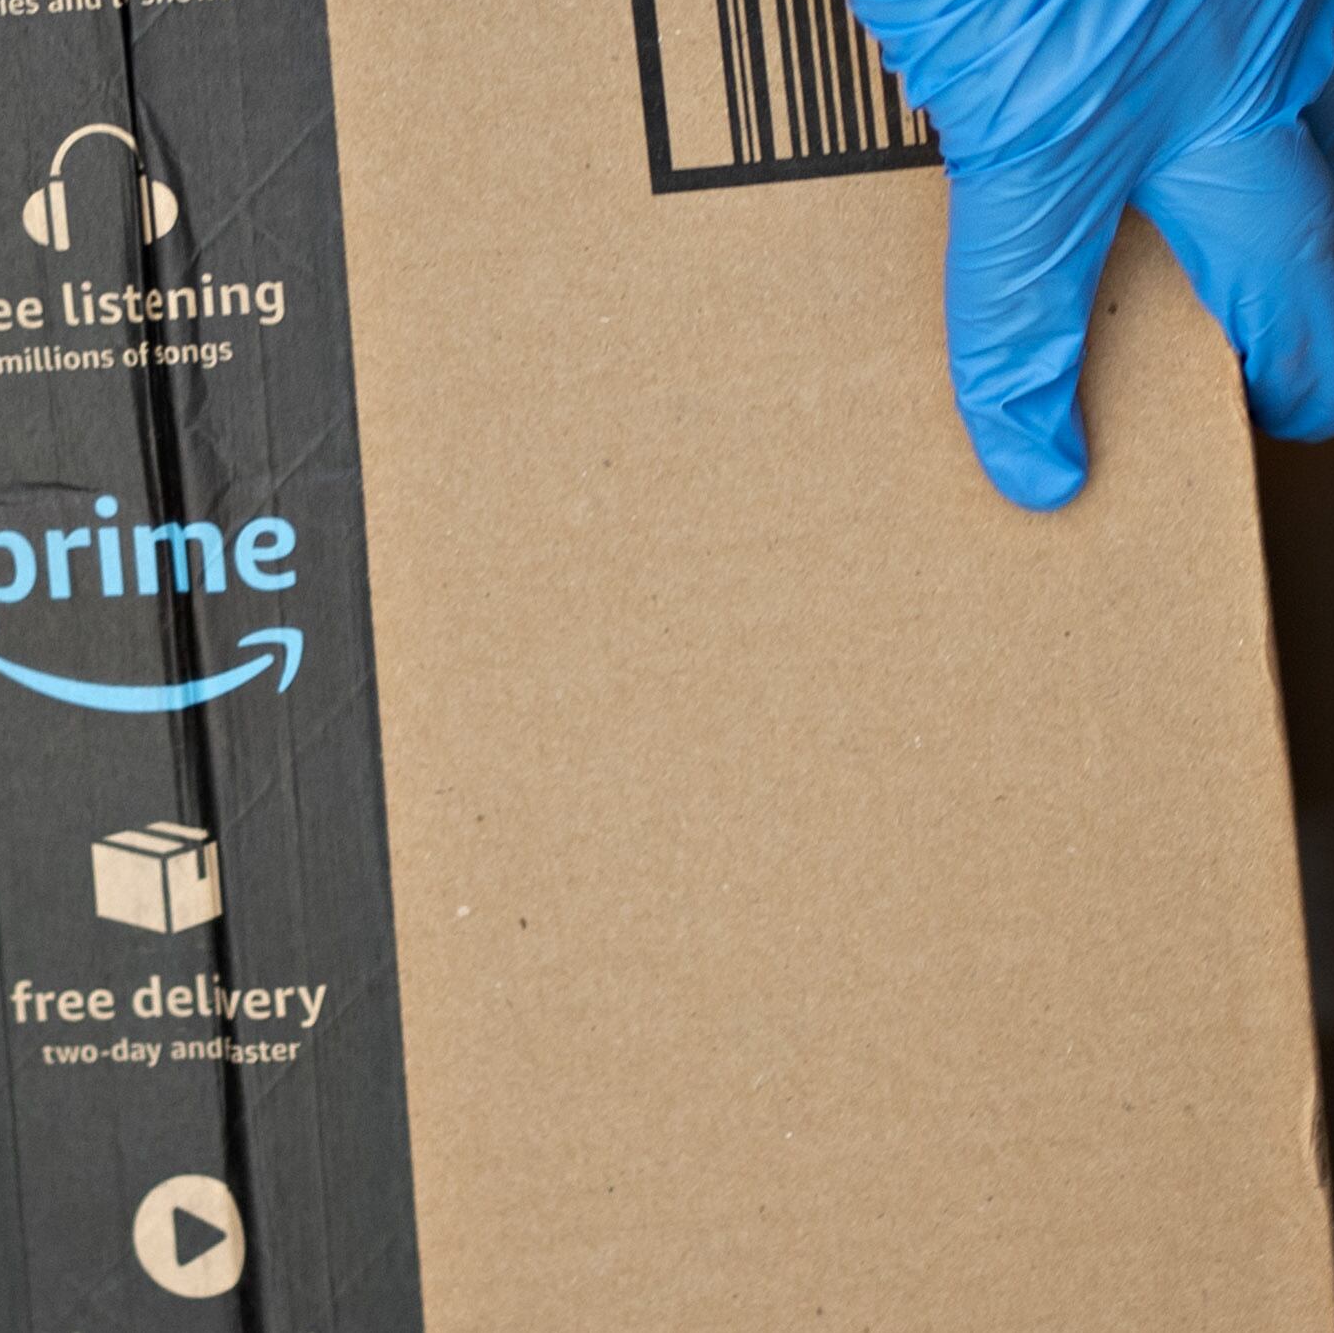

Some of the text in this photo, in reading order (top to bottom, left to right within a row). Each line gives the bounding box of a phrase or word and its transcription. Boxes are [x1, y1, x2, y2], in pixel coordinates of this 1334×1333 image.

[61, 271, 286, 327] listening
[121, 340, 149, 368] of
[154, 340, 234, 370] songs
[9, 973, 328, 1029] free delivery
[41, 1037, 162, 1069] two-day
[170, 1037, 223, 1061] and
